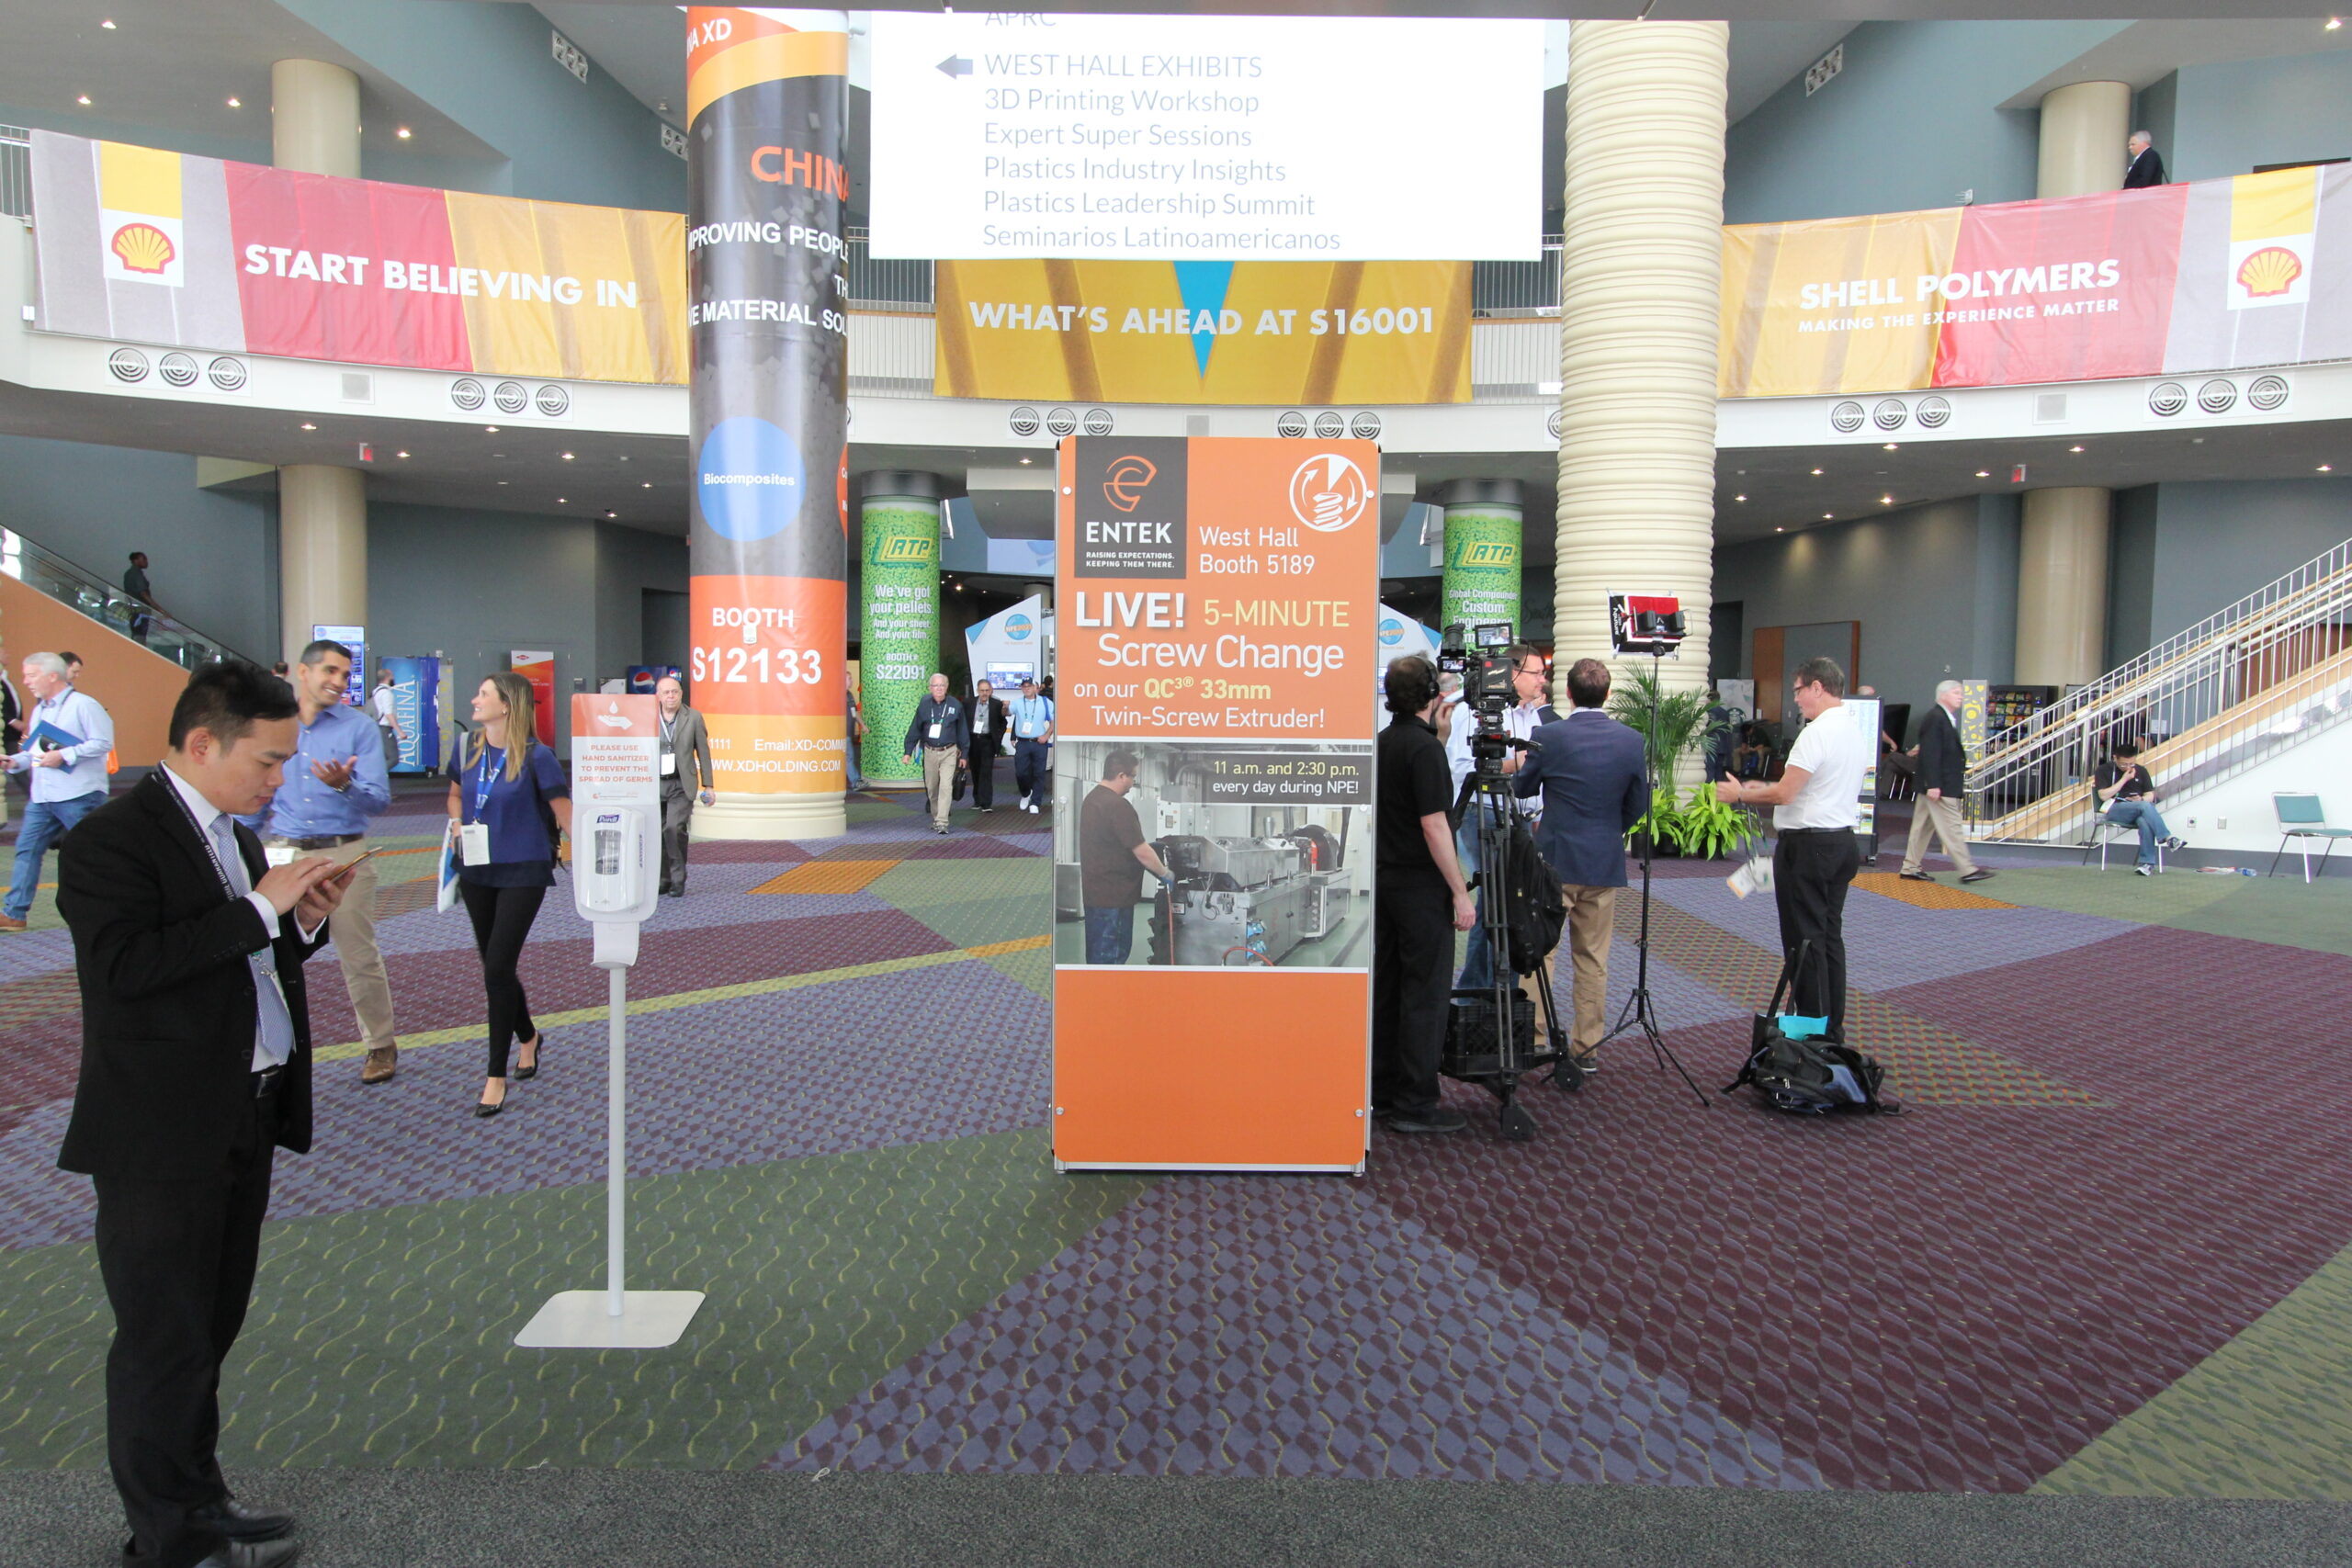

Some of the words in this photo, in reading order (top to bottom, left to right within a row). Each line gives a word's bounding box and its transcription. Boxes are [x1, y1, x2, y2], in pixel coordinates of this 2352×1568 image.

[702, 17, 732, 45] XD
[985, 53, 1059, 76] WEST
[1068, 54, 1134, 77] HALL
[1142, 55, 1262, 79] EXHIBITS
[985, 88, 1020, 109] 3D
[1028, 88, 1125, 116] Printing
[1131, 89, 1260, 116] Workshop
[985, 122, 1065, 149] Expert
[1072, 123, 1142, 149] Super
[1149, 123, 1251, 148] Sessions
[985, 156, 1075, 179] Plastics
[1083, 158, 1183, 184] Industry
[1193, 158, 1286, 184] Insights
[984, 190, 1075, 213] Plastics
[1083, 191, 1216, 219] Leadership
[1223, 192, 1316, 216] Summit
[983, 224, 1116, 248] Seminarios
[1125, 225, 1340, 251] Latinoamericanos
[244, 243, 369, 287] START
[383, 260, 582, 305] BELIEVING
[596, 277, 637, 309] IN
[1799, 277, 1904, 310] SHELL
[1917, 258, 2120, 301] POLYMERS
[703, 299, 817, 327] MATERIAL
[968, 302, 1109, 333] WHAT'S
[1121, 308, 1242, 335] AHEAD
[1254, 309, 1296, 335] AT
[1309, 307, 1432, 335] S16001
[1798, 317, 1874, 333] MAKING
[1883, 313, 1915, 328] THE
[1922, 305, 2036, 325] EXPERIENCE
[2043, 298, 2120, 315] MATTER
[704, 472, 796, 487] Biocomposites
[1086, 521, 1172, 544] ENTEK
[1199, 525, 1250, 547] West
[1259, 525, 1298, 547] Hall
[1200, 554, 1258, 574] Booth
[1267, 555, 1315, 575] 5189
[875, 584, 910, 598] We've
[914, 586, 930, 601] got
[1449, 589, 1471, 599] Global
[712, 607, 794, 627] BOOTH
[869, 603, 892, 615] your
[894, 602, 934, 615] pellets.
[1076, 591, 1185, 628] LIVE!
[1204, 599, 1350, 627] 5-MINUTE
[1463, 601, 1505, 613] Custom
[874, 619, 888, 627] And
[889, 620, 909, 629] your
[876, 630, 890, 638] And
[892, 631, 910, 640] your
[692, 647, 822, 684] S12133
[886, 653, 911, 661] BOOTH
[1098, 633, 1207, 668] Screw
[1216, 634, 1345, 678] Change
[876, 665, 926, 680] S22091
[1074, 682, 1098, 698] on
[1104, 682, 1138, 698] our
[1201, 678, 1272, 700] 33mm
[397, 680, 418, 767] AQUAFINA
[1091, 705, 1220, 728] Twin-Screw
[1226, 706, 1325, 728] Extruder!
[1214, 761, 1227, 775] 11
[1233, 763, 1262, 775] a.m.
[1267, 761, 1293, 775] and
[1297, 761, 1326, 776] 2:30
[1330, 764, 1360, 779] p.m.
[1213, 781, 1249, 796] every
[1253, 780, 1275, 796] day
[1280, 780, 1323, 796] during
[1327, 780, 1359, 795] NPE!
